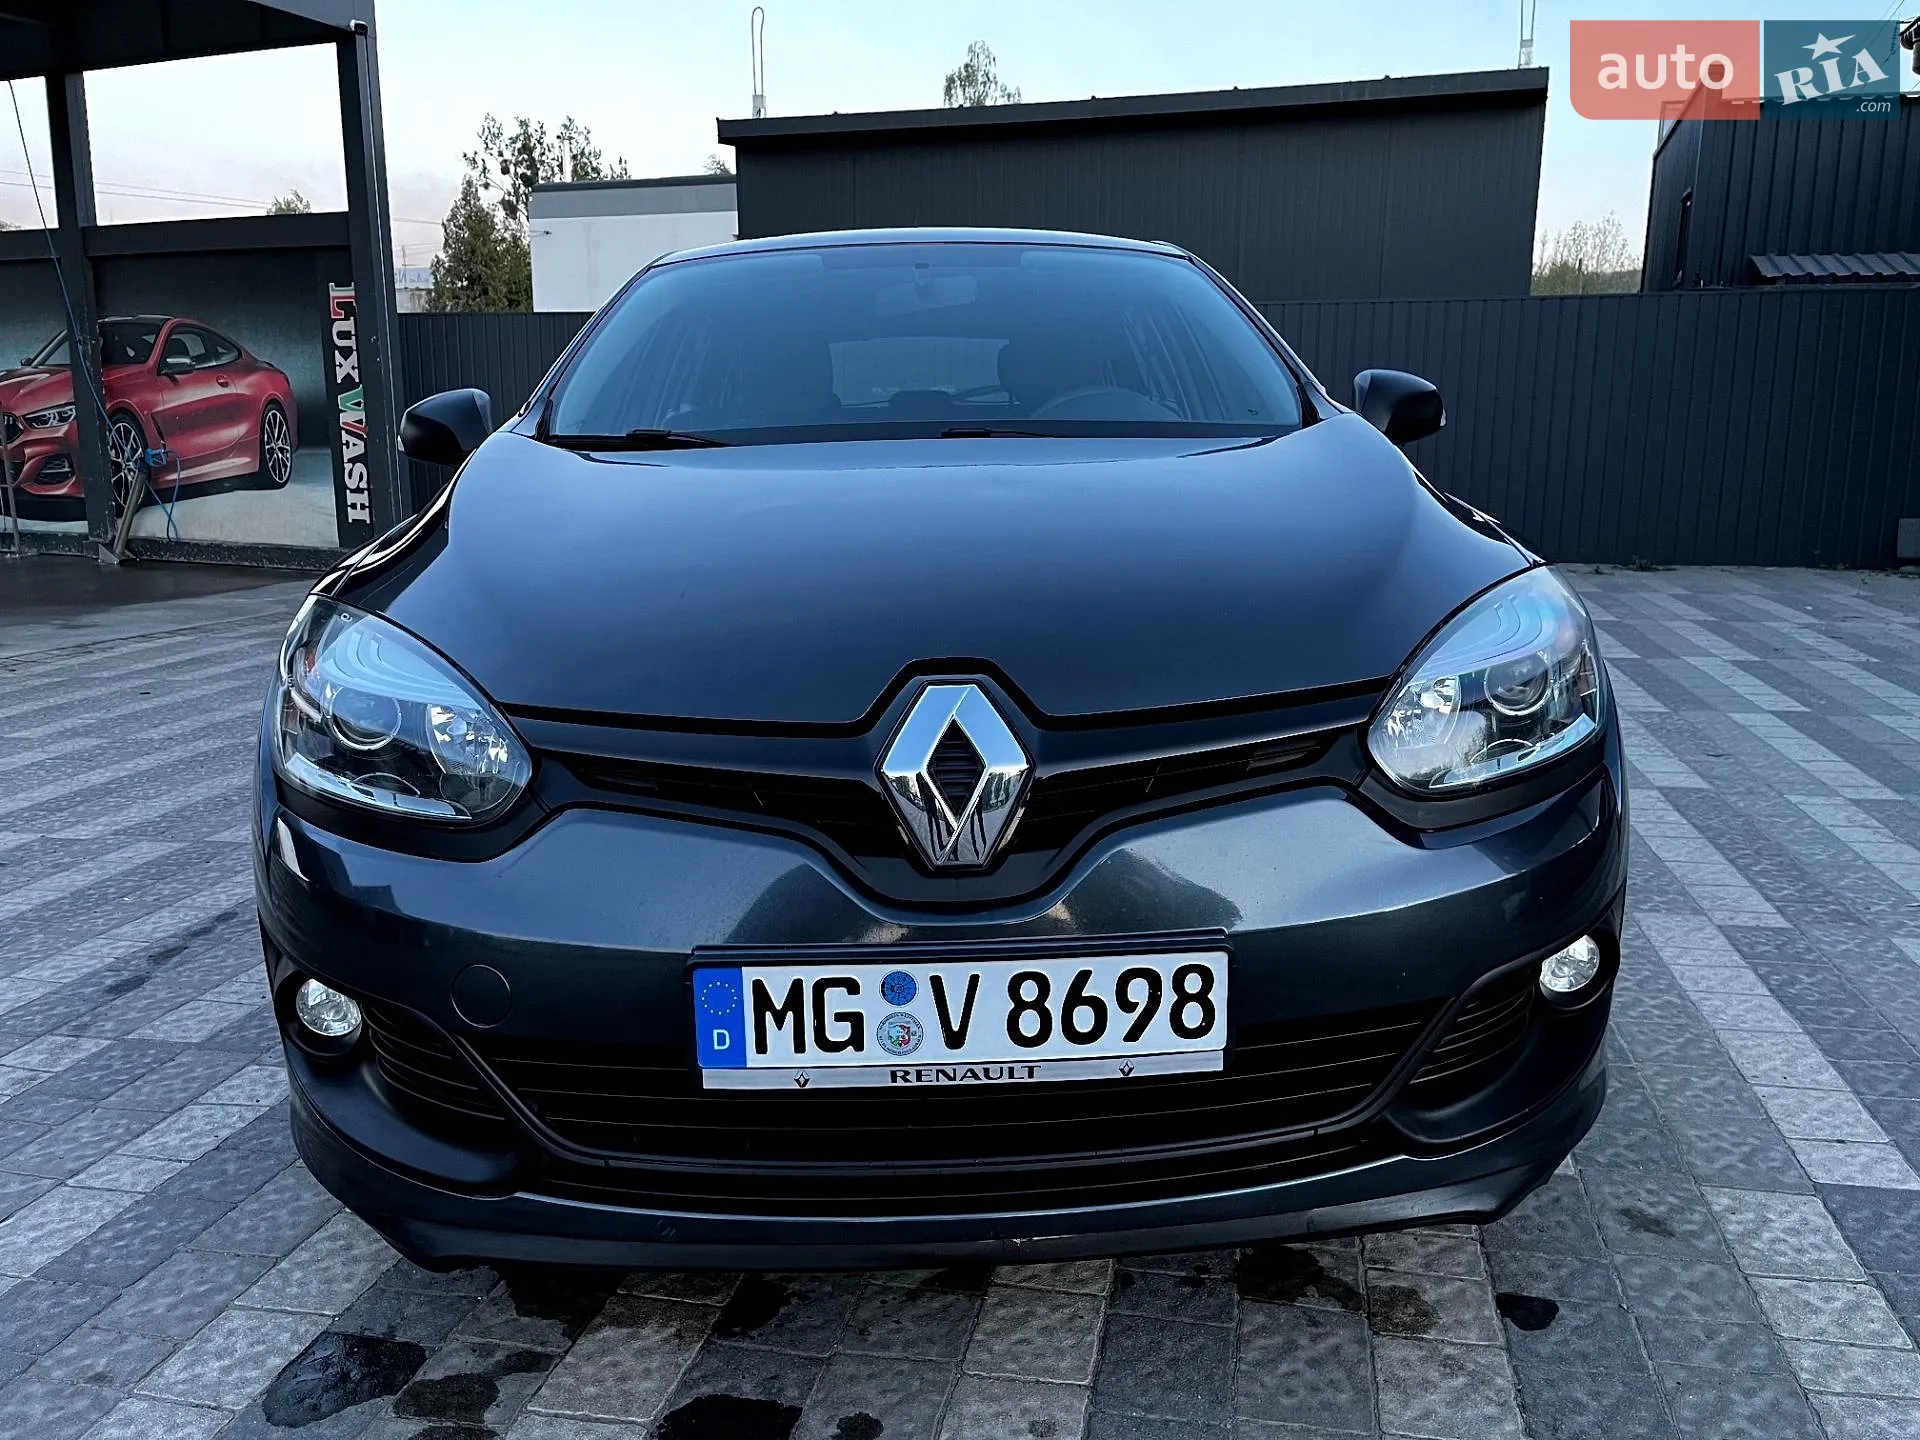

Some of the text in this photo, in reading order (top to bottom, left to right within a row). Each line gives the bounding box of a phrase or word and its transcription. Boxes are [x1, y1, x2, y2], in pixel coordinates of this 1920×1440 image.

[328, 282, 371, 524] LUX WASH
[751, 975, 866, 1055] MG
[929, 972, 981, 1051] V
[1006, 962, 1217, 1049] 8698
[713, 1028, 730, 1051] D
[889, 1064, 1042, 1084] RENAULT
